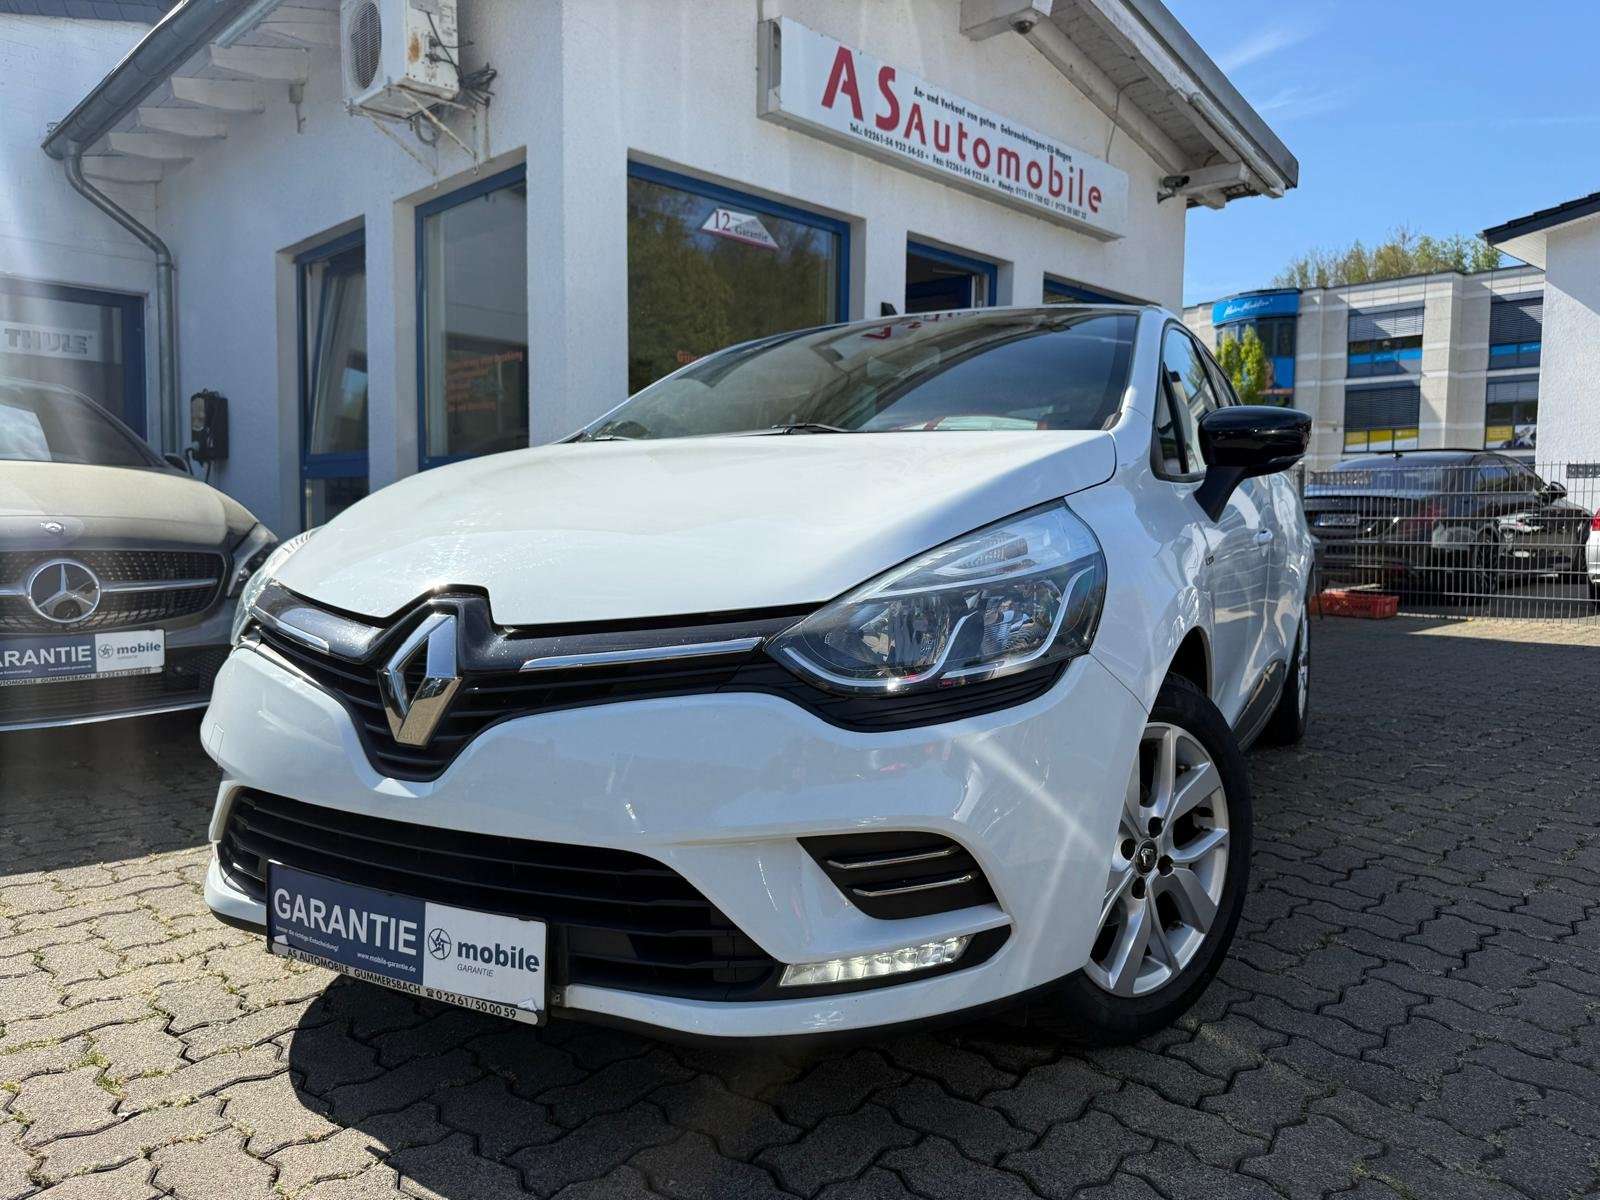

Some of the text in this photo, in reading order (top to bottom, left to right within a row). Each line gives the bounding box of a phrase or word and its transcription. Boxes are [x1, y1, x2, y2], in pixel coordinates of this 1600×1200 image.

[926, 93, 939, 105] und
[940, 98, 965, 116] Verkauf
[967, 111, 978, 122] von
[979, 117, 997, 130] guten
[714, 211, 731, 232] 12
[4, 328, 88, 355] THULE
[0, 645, 92, 667] RANTIE
[117, 641, 161, 654] mobile
[274, 888, 418, 956] GARANTIE
[357, 951, 417, 974] www.mobile-garantie.de
[457, 940, 540, 973] mobile
[287, 948, 298, 958] AS
[300, 950, 350, 974] AUTOMOBILE
[354, 968, 421, 994] GUMMERSBACH
[457, 963, 494, 978] GARANTIE
